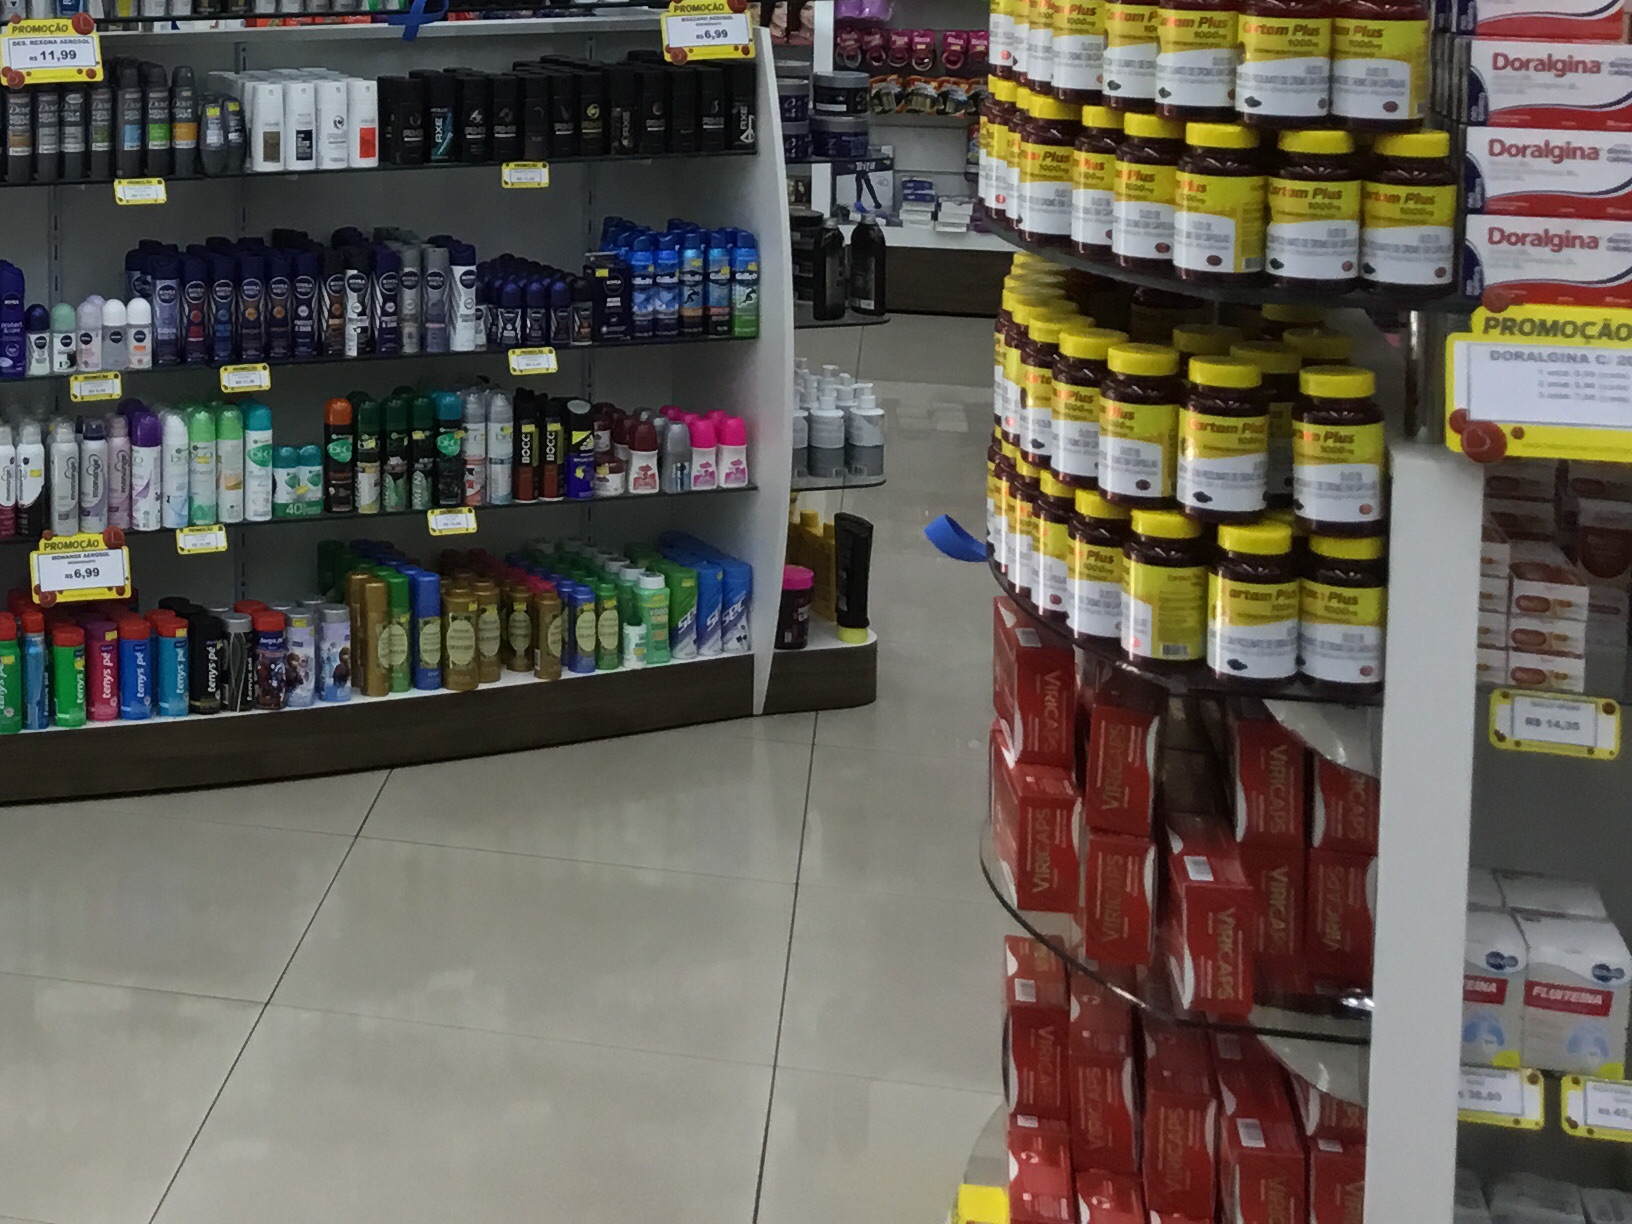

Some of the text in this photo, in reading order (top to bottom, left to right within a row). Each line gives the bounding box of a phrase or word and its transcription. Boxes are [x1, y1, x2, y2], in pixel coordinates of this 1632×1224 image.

[673, 3, 725, 14] PROMOÇÃO
[11, 23, 69, 35] PROMOÇÃO
[704, 29, 729, 40] 6,99
[40, 50, 77, 63] 11,99
[1492, 52, 1602, 78] Doralgina
[435, 117, 443, 143] AXE
[1487, 138, 1600, 164] Doralgina
[1487, 226, 1600, 253] Doralgina
[1483, 316, 1632, 346] PROMOÇÃO
[1489, 349, 1591, 364] DORALGINA
[43, 539, 100, 551] PROMOÇÃO
[74, 567, 100, 580] 6,99
[1032, 807, 1051, 894] VIRICAPS
